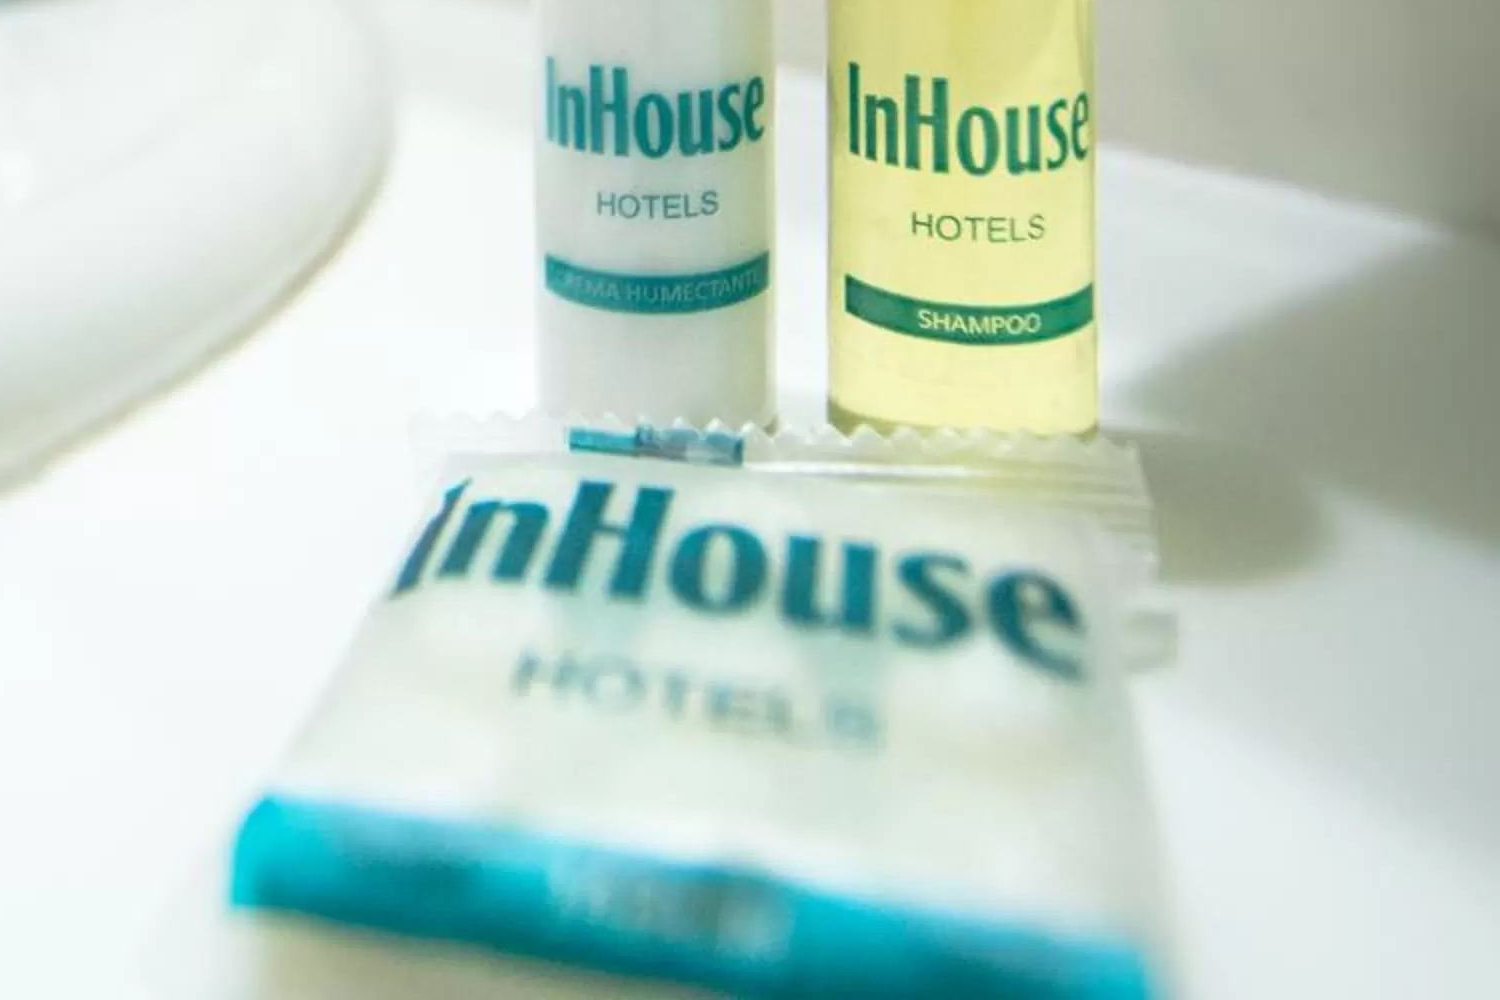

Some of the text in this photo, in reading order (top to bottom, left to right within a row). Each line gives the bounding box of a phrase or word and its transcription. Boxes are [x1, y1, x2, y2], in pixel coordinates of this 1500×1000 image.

[545, 56, 765, 158] InHouse
[848, 62, 1089, 177] InHouse
[596, 190, 720, 221] HOTELS
[911, 211, 1046, 243] HOTELS
[553, 268, 620, 300] REMA
[918, 308, 1042, 335] SHAMPOO
[390, 478, 1090, 682] InHouse
